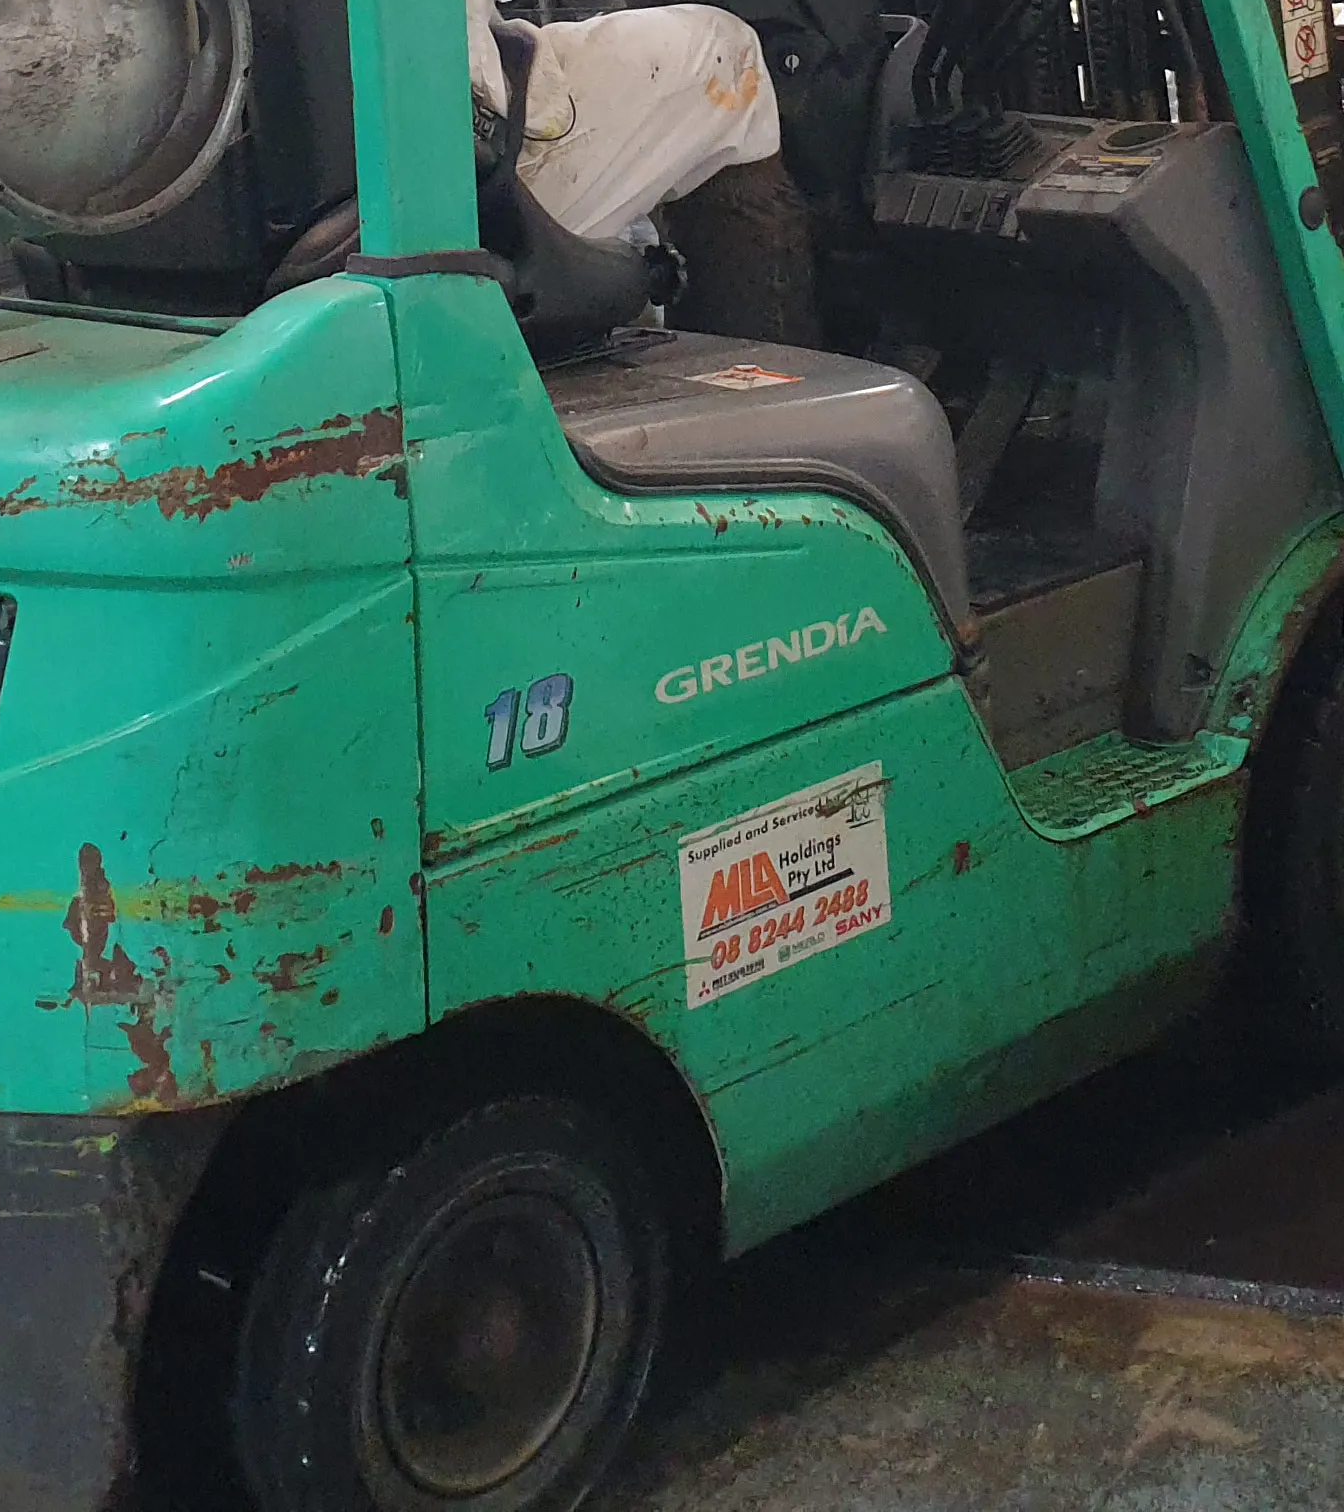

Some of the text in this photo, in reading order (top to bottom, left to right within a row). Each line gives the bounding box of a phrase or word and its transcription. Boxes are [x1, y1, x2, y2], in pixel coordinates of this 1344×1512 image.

[654, 606, 888, 704] GRENDIA
[484, 672, 574, 773] 18
[688, 830, 741, 864] Supplied
[745, 821, 768, 840] and
[772, 799, 821, 830] Serviced
[779, 834, 841, 869] Holdings
[700, 851, 790, 930] MLA
[788, 855, 835, 888] Pty Ltd
[711, 935, 741, 971] 08
[747, 905, 805, 954] 8244
[813, 879, 869, 926] 2488
[836, 904, 883, 935] SANY
